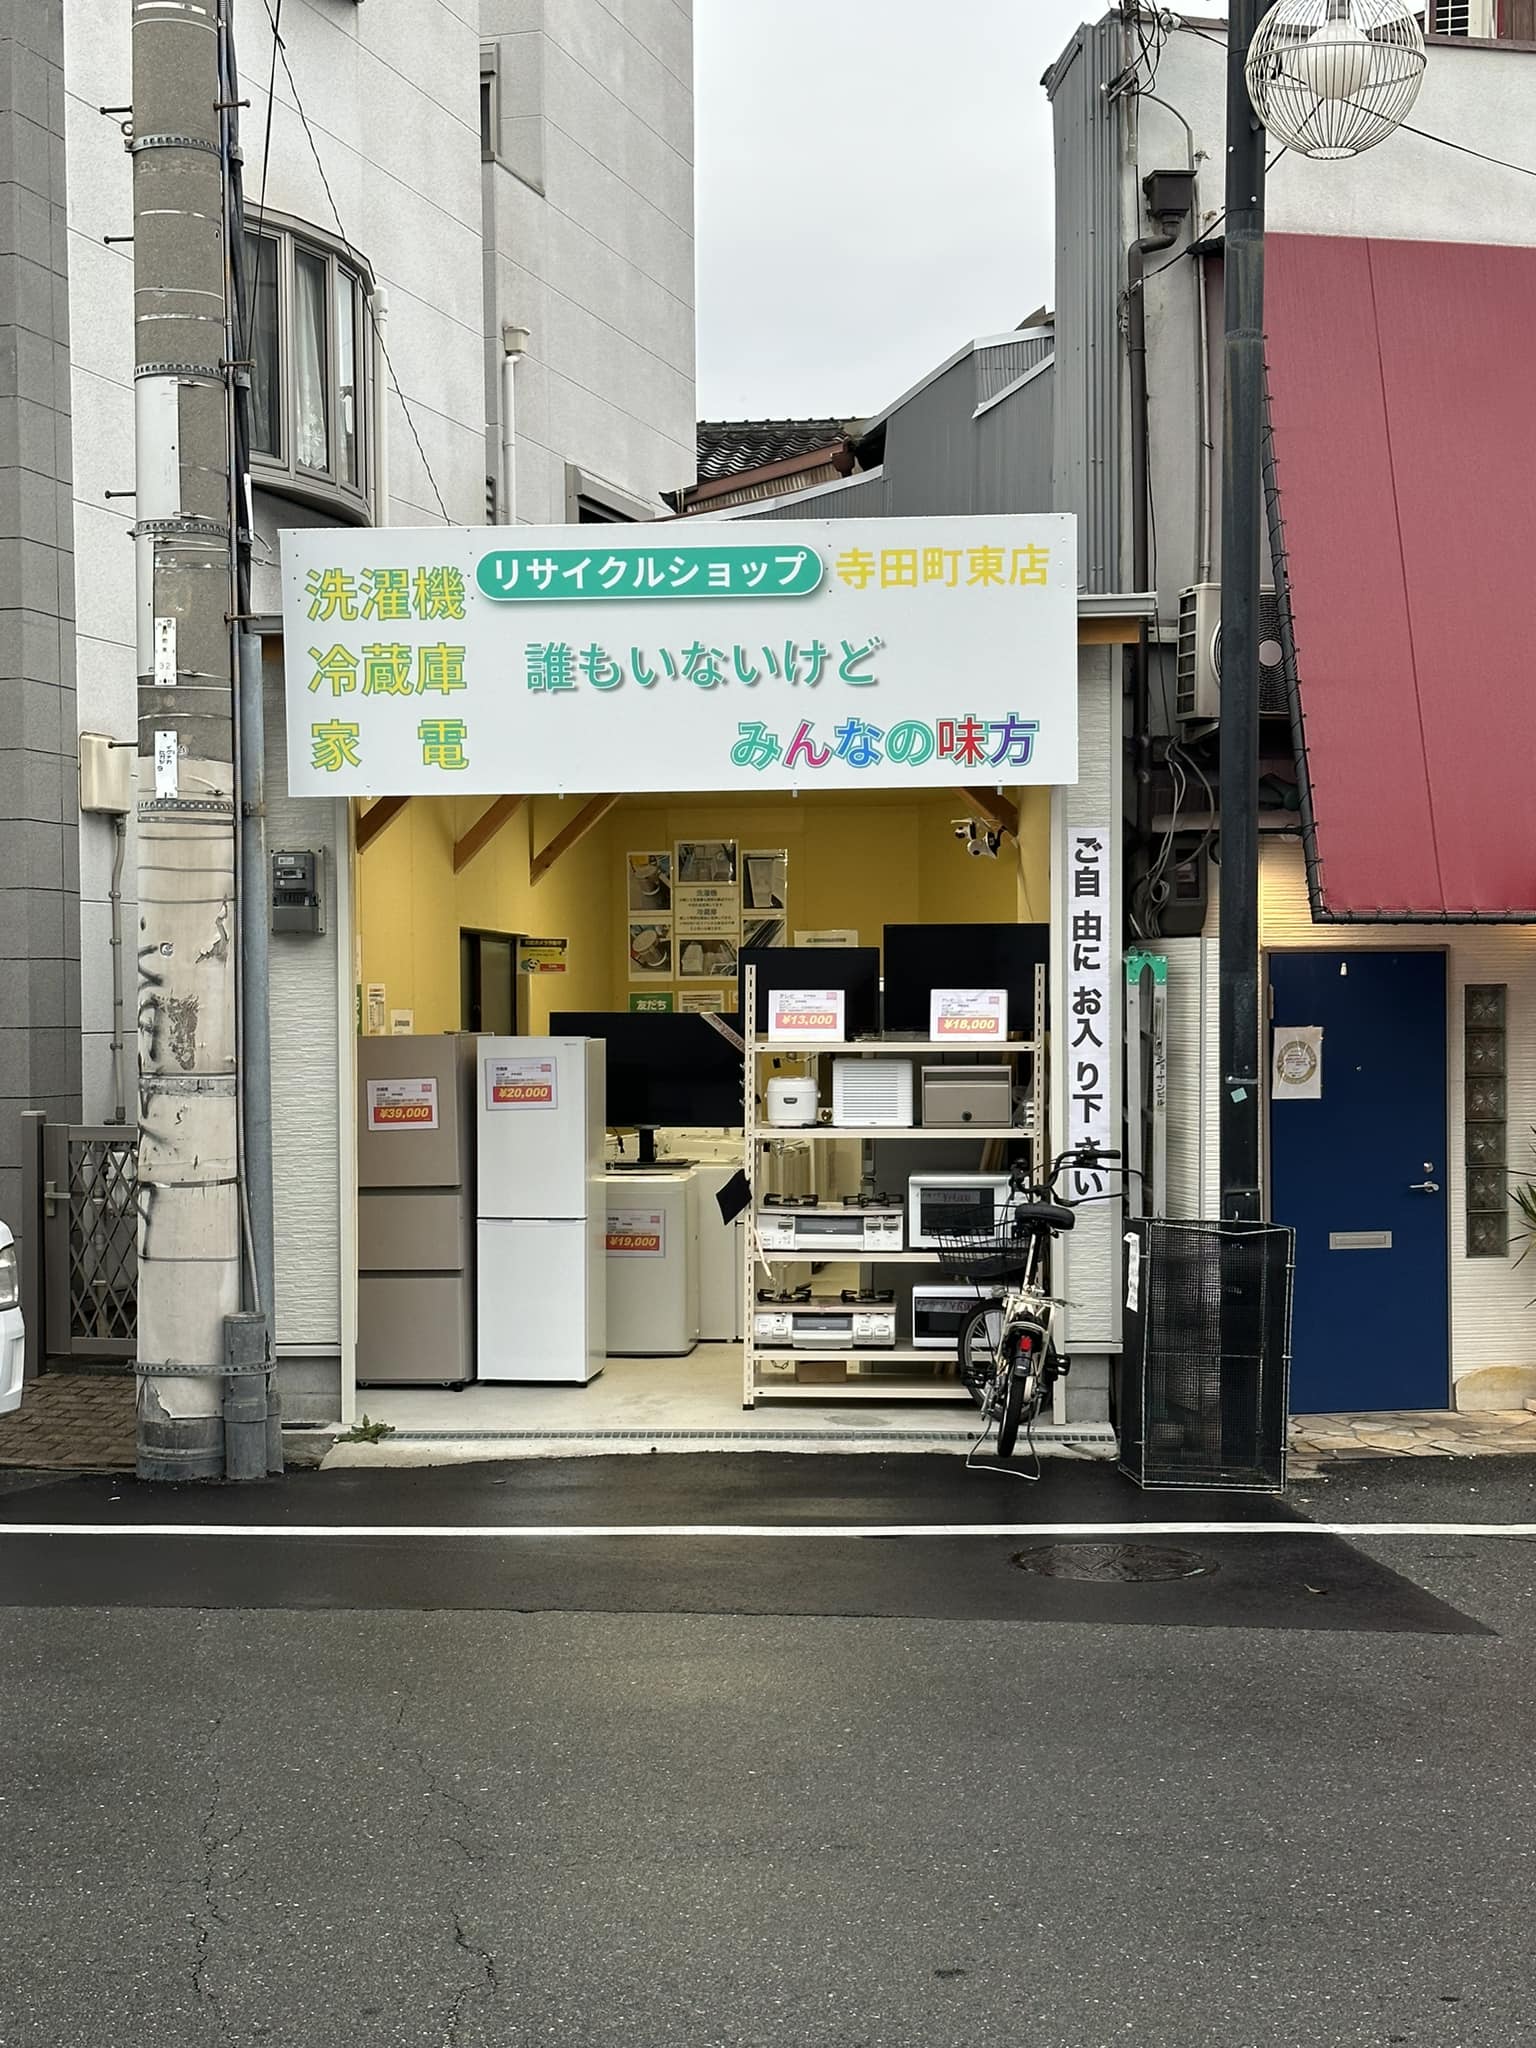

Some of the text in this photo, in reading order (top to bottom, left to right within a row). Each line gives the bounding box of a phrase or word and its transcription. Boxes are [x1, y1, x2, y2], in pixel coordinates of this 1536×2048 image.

[495, 551, 807, 591] リサイクルショップ
[836, 544, 1050, 590] 寺田町東店
[305, 567, 466, 622] 洗濯機
[307, 641, 467, 697] 冷蔵庫
[524, 636, 883, 692] 誰もいないけど
[730, 712, 1040, 771] みんなの味方
[636, 1000, 667, 1010] 友だち
[782, 1015, 833, 1026] ¥13,000
[943, 1019, 995, 1030] ¥18,000
[499, 1087, 548, 1099] ¥20,000
[380, 1107, 429, 1119] ¥39,000
[609, 1237, 657, 1248] ¥19,000
